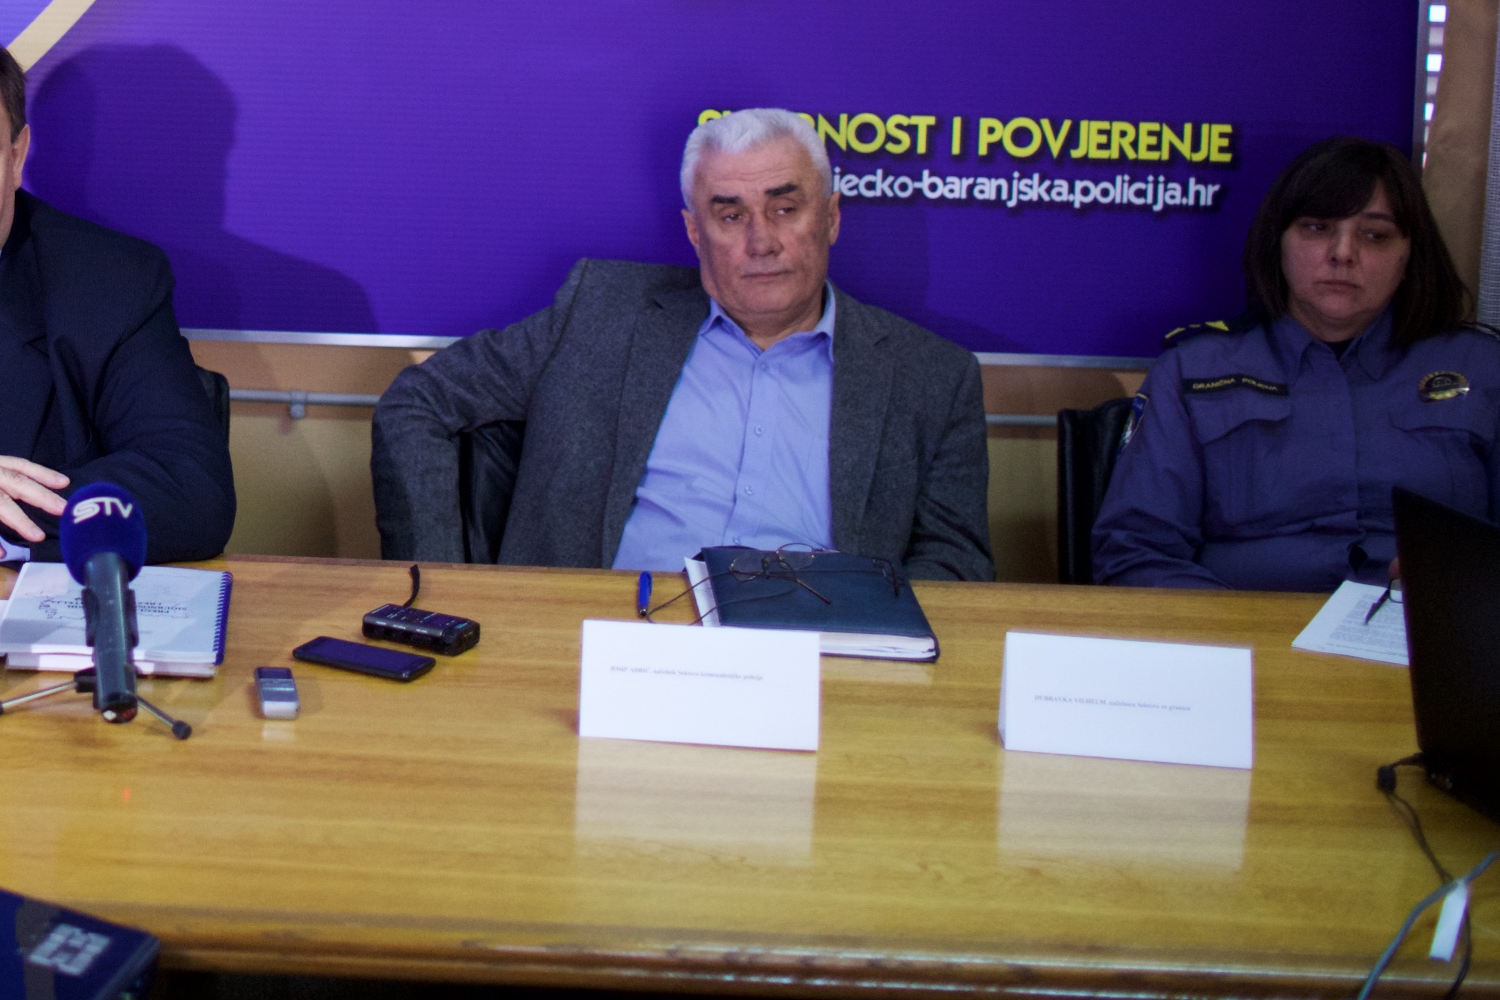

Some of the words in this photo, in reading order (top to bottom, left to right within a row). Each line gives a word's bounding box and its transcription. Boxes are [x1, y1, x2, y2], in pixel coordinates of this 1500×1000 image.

[950, 117, 962, 156] I
[977, 117, 1234, 163] POVJERENJE
[72, 496, 133, 524] STV
